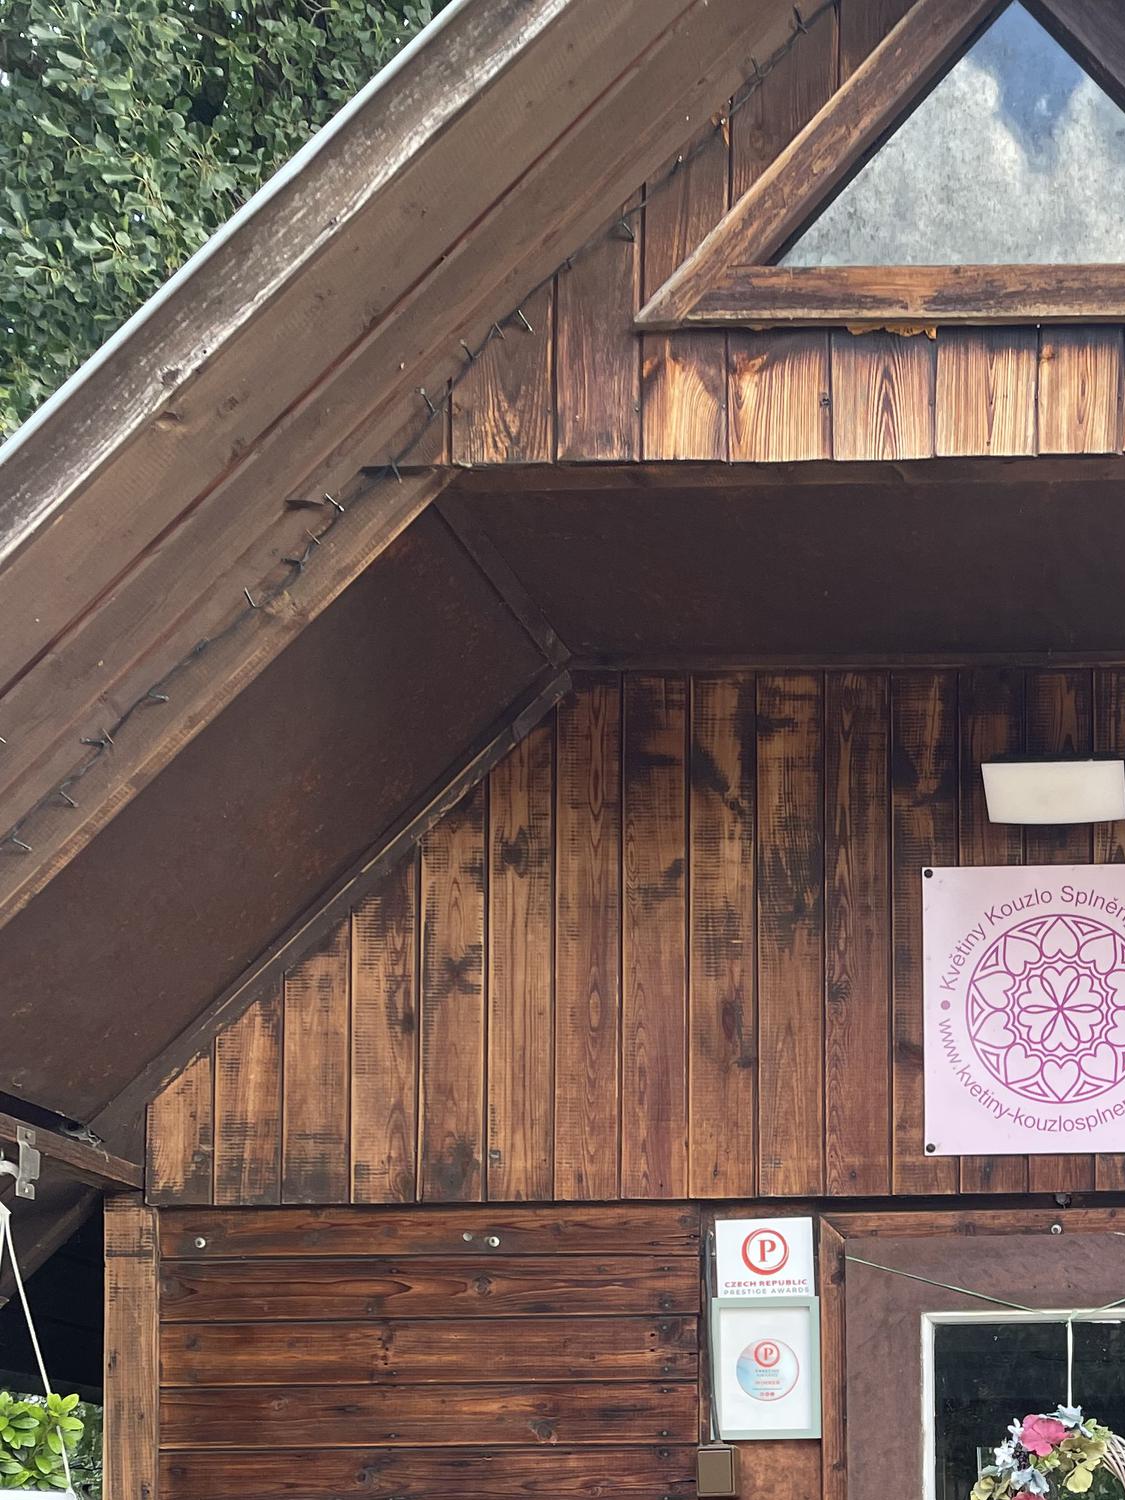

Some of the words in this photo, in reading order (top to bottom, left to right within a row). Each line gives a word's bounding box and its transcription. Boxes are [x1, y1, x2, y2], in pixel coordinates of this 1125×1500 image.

[939, 923, 987, 991] Květiny
[984, 888, 1053, 926] Kouzlo
[757, 1239, 777, 1262] P
[759, 1279, 808, 1287] REPUBLIC
